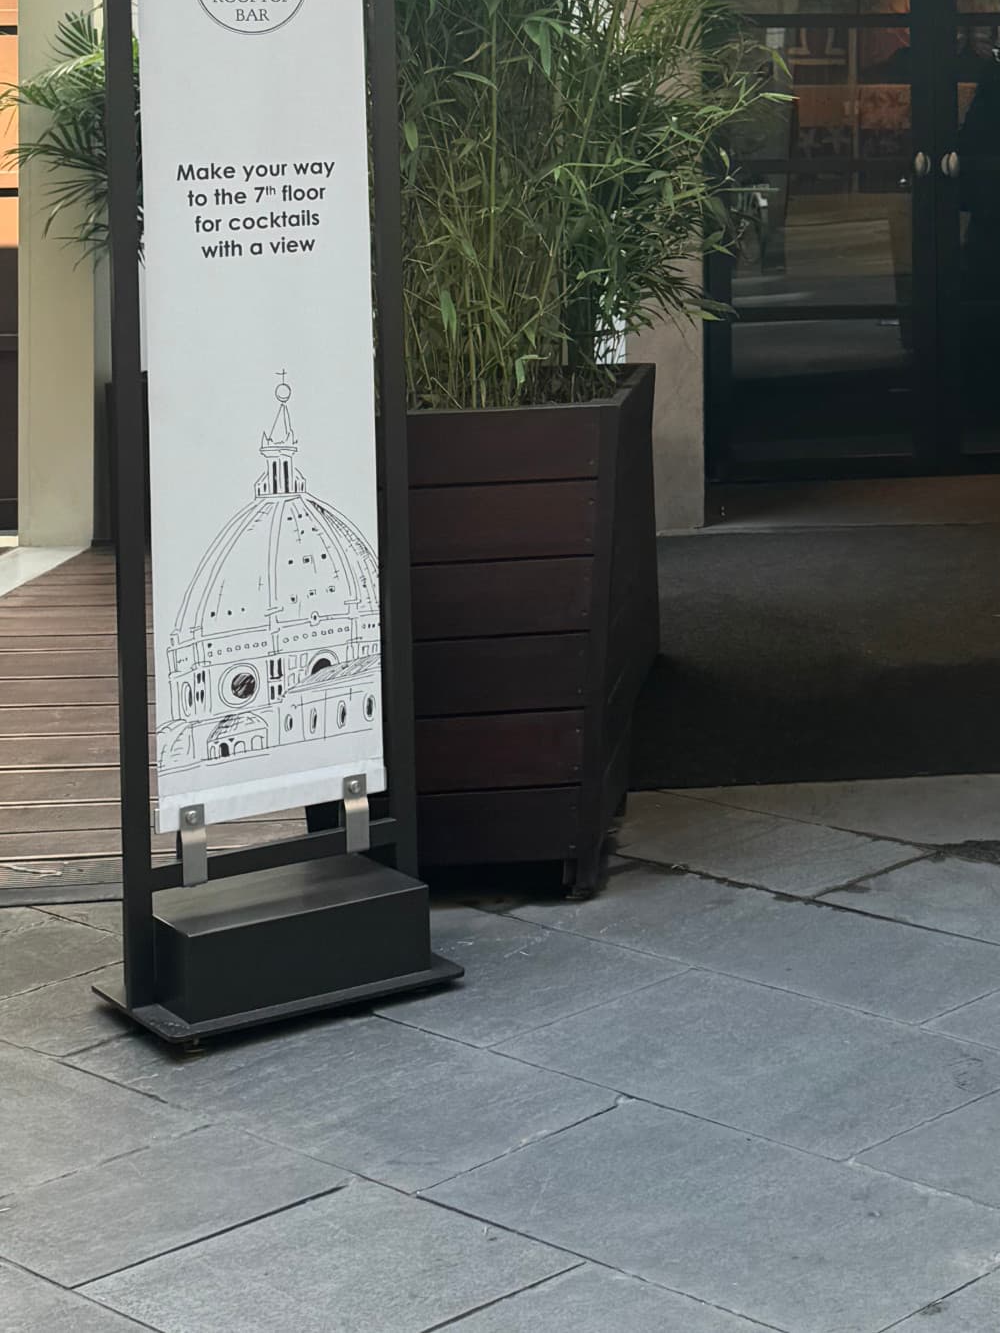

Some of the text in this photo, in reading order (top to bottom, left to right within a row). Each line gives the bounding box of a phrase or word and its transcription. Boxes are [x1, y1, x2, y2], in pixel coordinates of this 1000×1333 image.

[235, 8, 269, 21] BAR
[176, 161, 335, 181] Make your way
[187, 184, 326, 206] to the 7th floor
[195, 209, 319, 233] for cocktails
[201, 236, 315, 258] with a view
